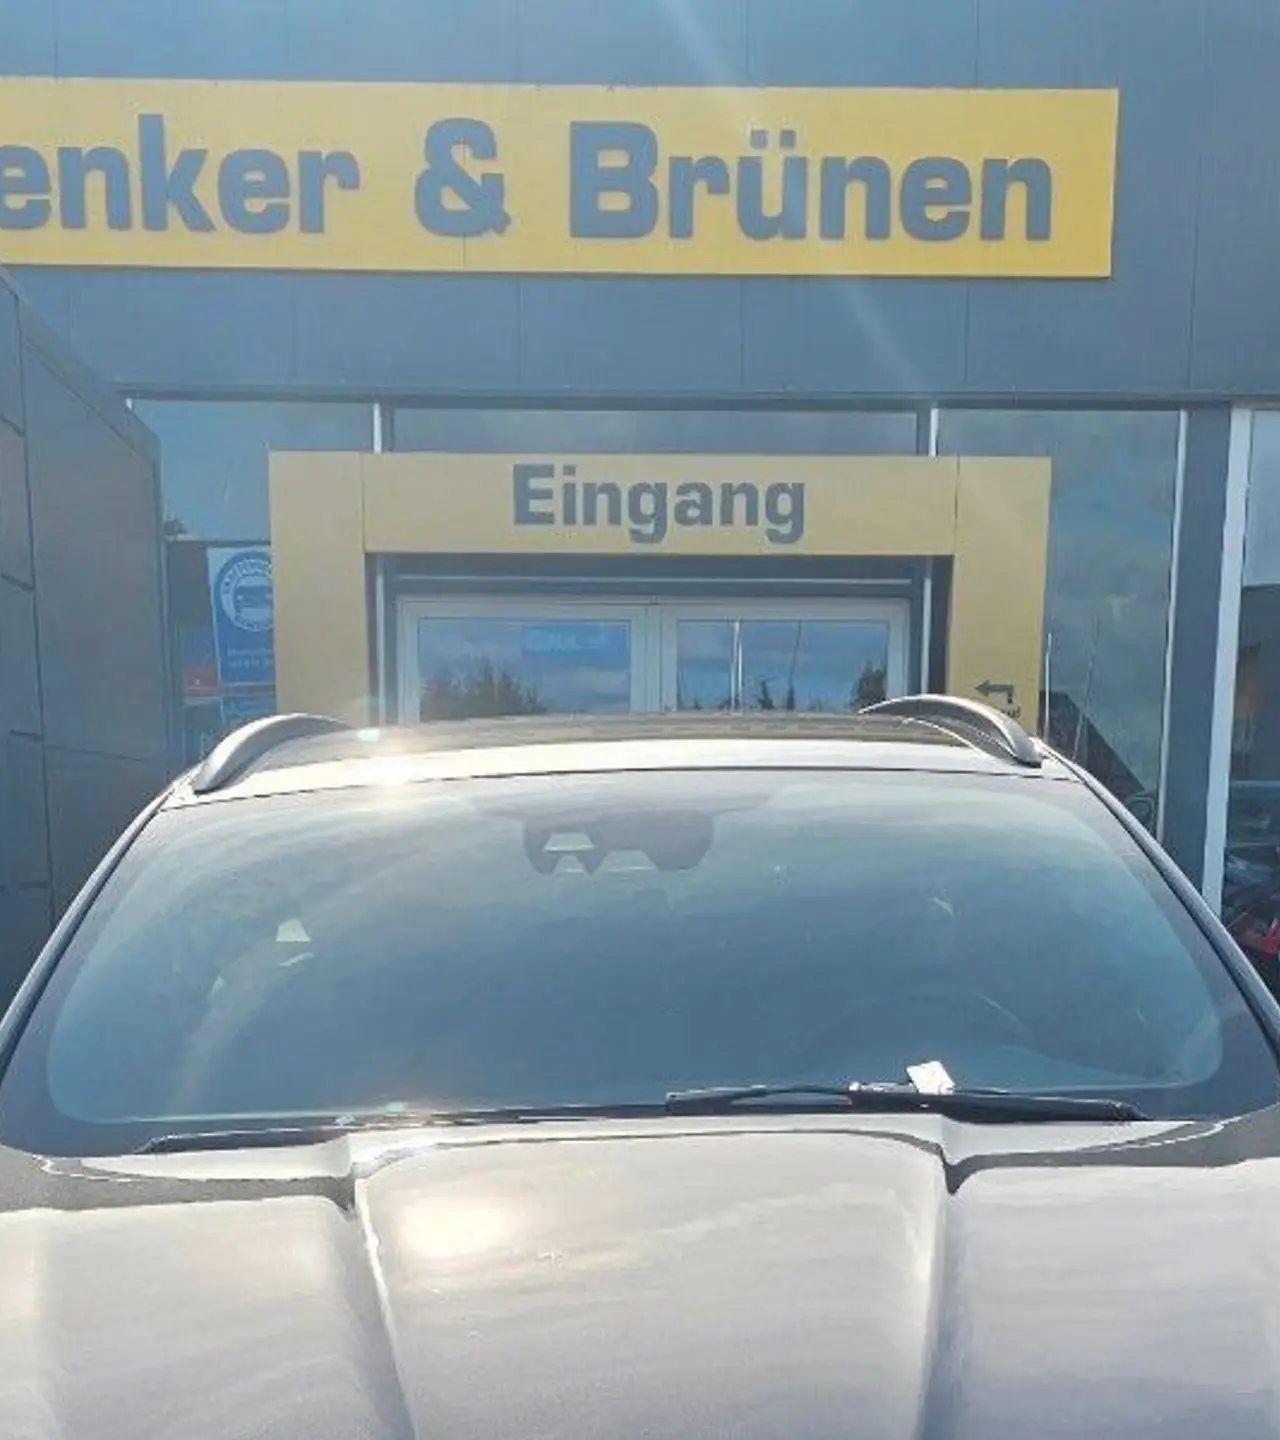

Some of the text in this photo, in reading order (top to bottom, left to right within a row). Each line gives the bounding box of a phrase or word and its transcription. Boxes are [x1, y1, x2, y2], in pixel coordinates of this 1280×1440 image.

[414, 117, 512, 238] &
[568, 120, 1053, 242] Brünen
[512, 463, 806, 544] Eingang
